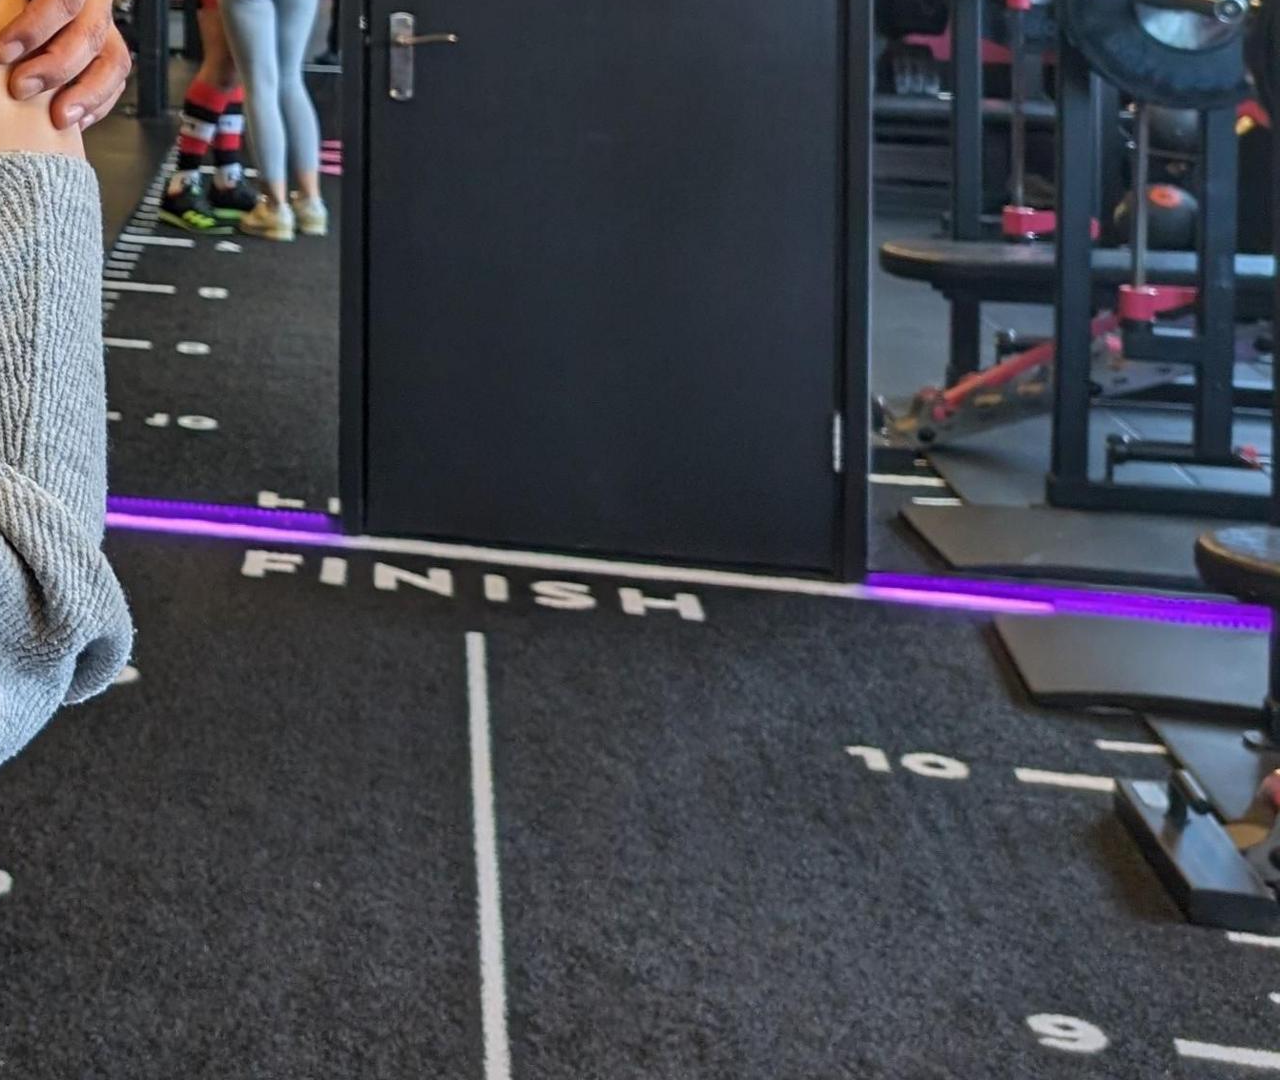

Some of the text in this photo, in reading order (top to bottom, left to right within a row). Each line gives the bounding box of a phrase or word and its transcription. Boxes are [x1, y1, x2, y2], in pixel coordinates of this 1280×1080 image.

[241, 549, 706, 622] FINISH
[844, 744, 970, 779] 10
[1027, 1013, 1109, 1054] 9
